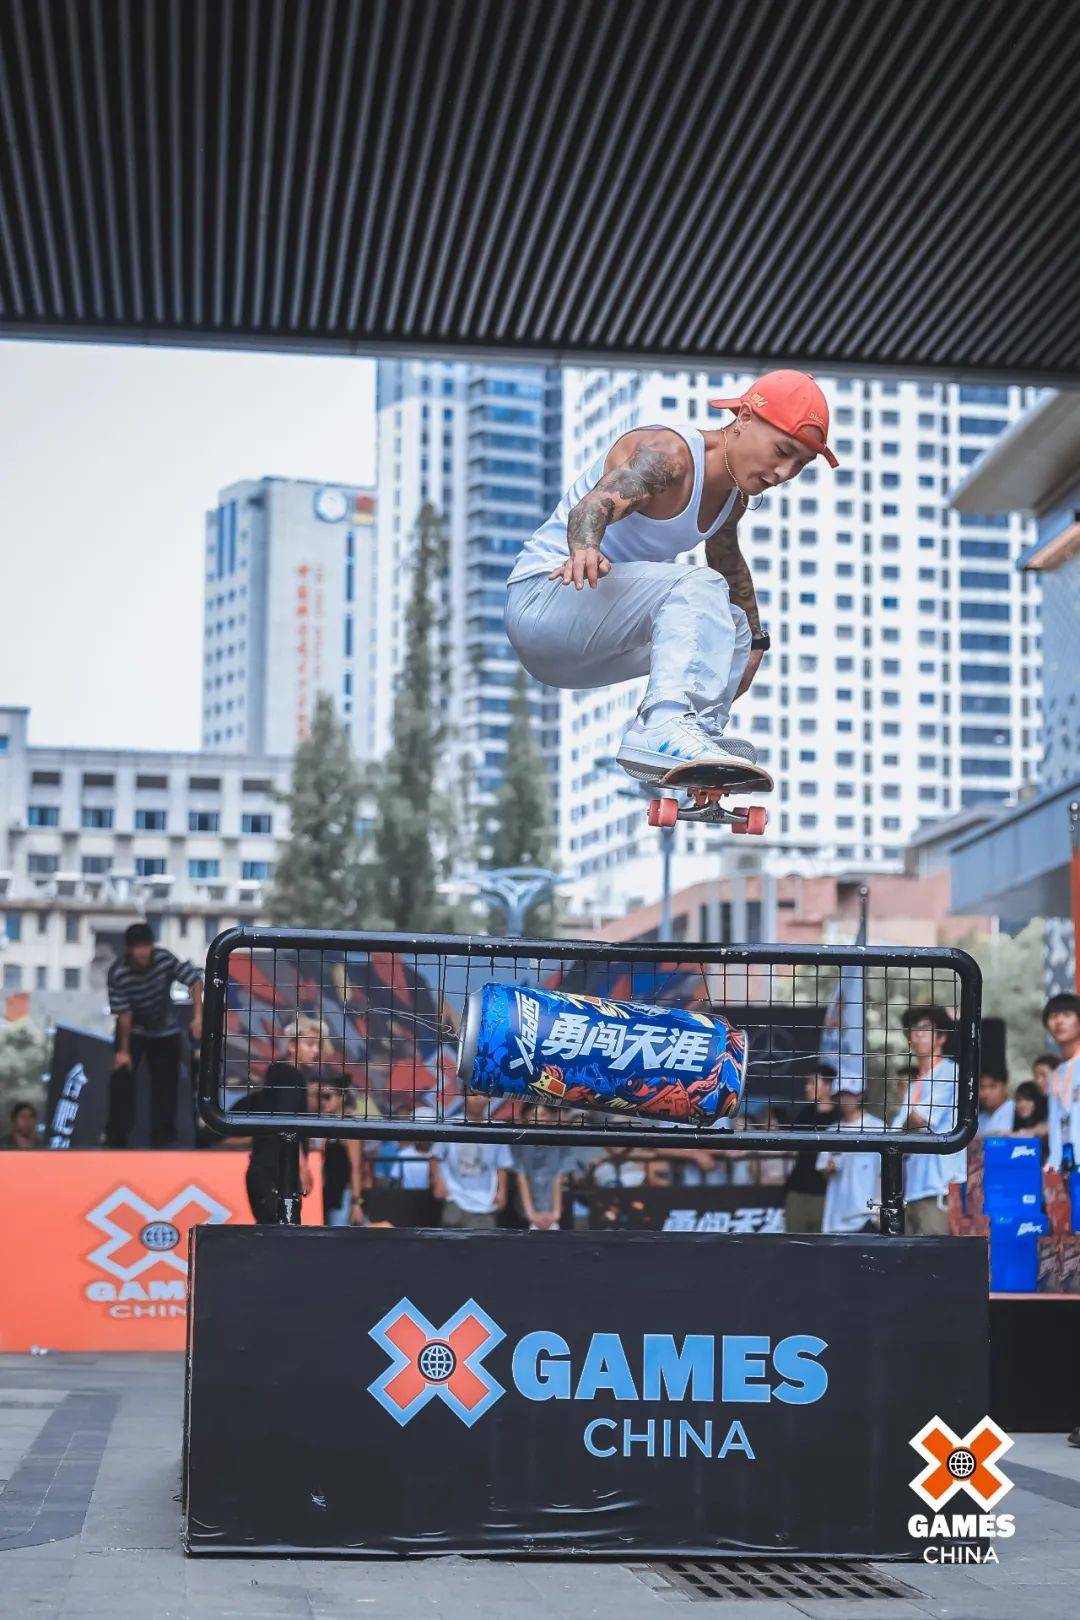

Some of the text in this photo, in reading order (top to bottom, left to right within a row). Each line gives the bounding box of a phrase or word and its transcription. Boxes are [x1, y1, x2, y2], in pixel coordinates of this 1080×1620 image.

[541, 1012, 713, 1073] 勇闯天涯
[86, 1281, 186, 1302] GAM
[109, 1303, 187, 1319] CHIN
[511, 1330, 829, 1405] GAMES
[583, 1417, 756, 1460] CHINA
